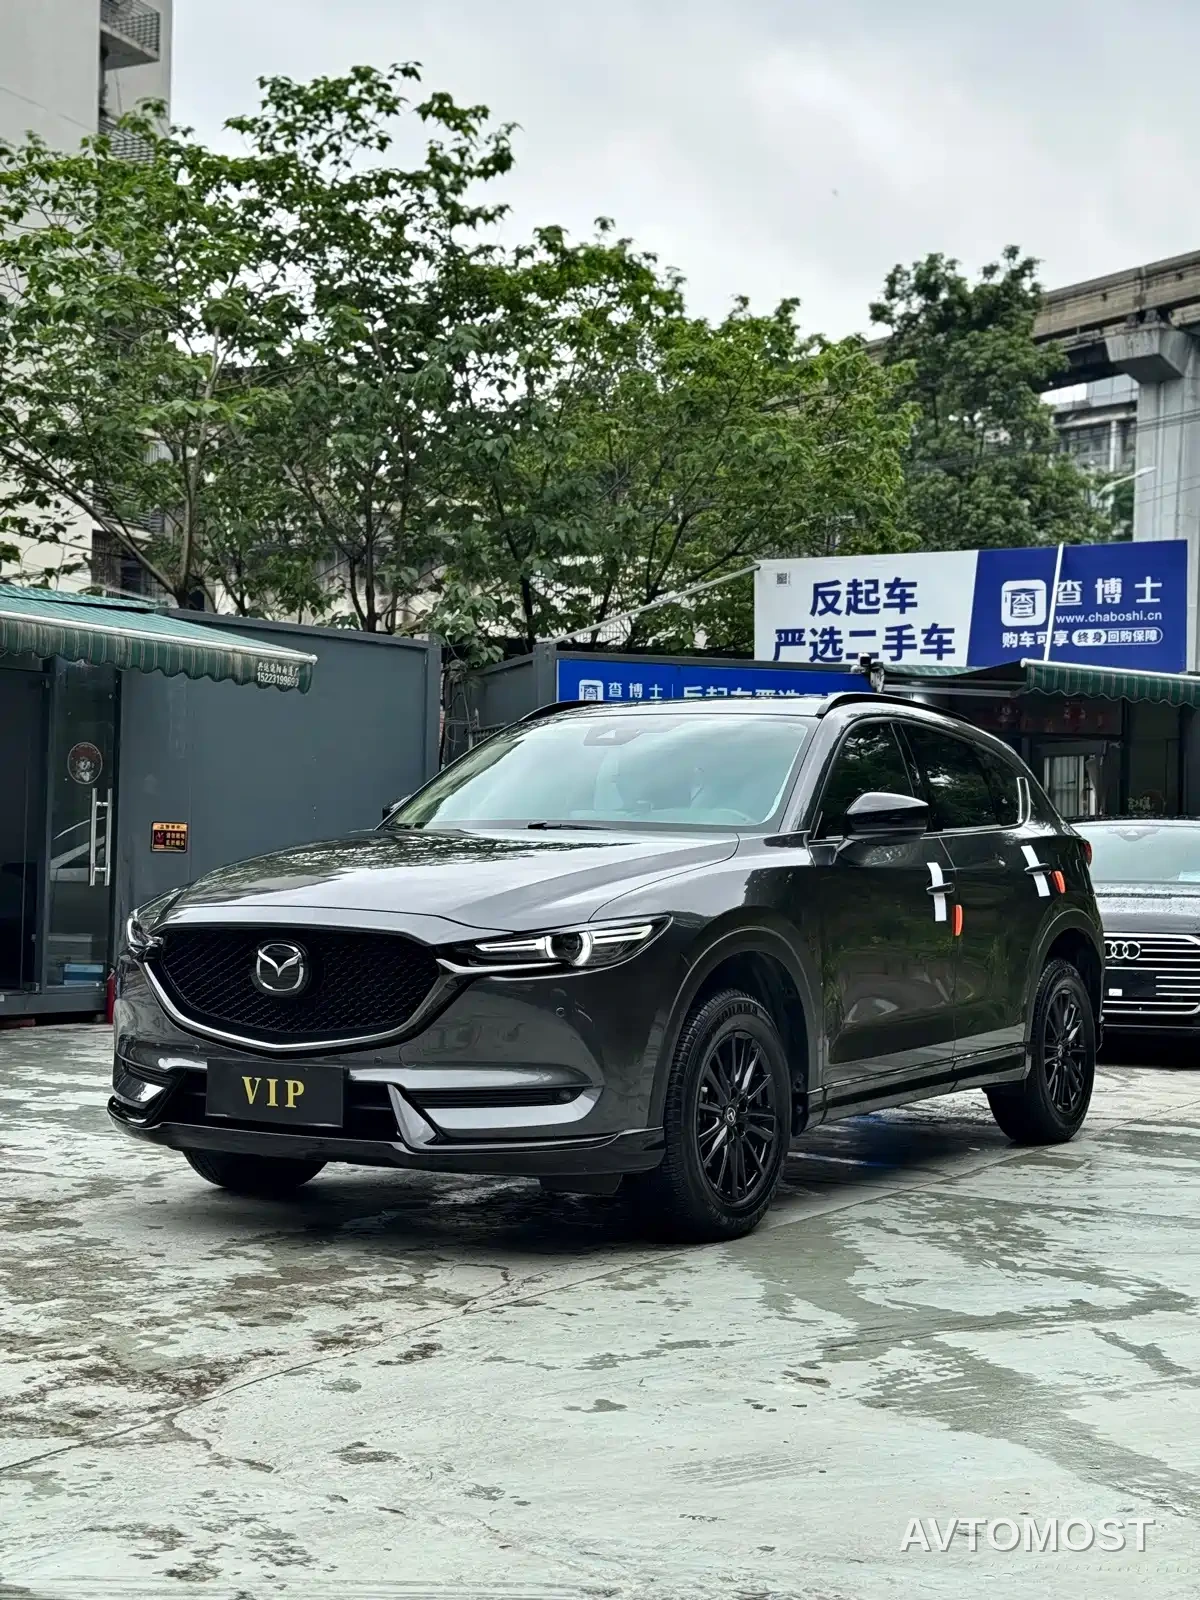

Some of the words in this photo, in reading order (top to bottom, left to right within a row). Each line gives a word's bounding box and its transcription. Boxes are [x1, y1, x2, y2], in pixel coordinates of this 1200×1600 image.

[809, 576, 918, 617] 反起车
[1055, 576, 1163, 606] 查博士
[1055, 610, 1163, 624] www.chaboshi.cn
[772, 622, 956, 663] 严选二手车
[608, 682, 664, 699] 查博士
[241, 1076, 305, 1108] VIP
